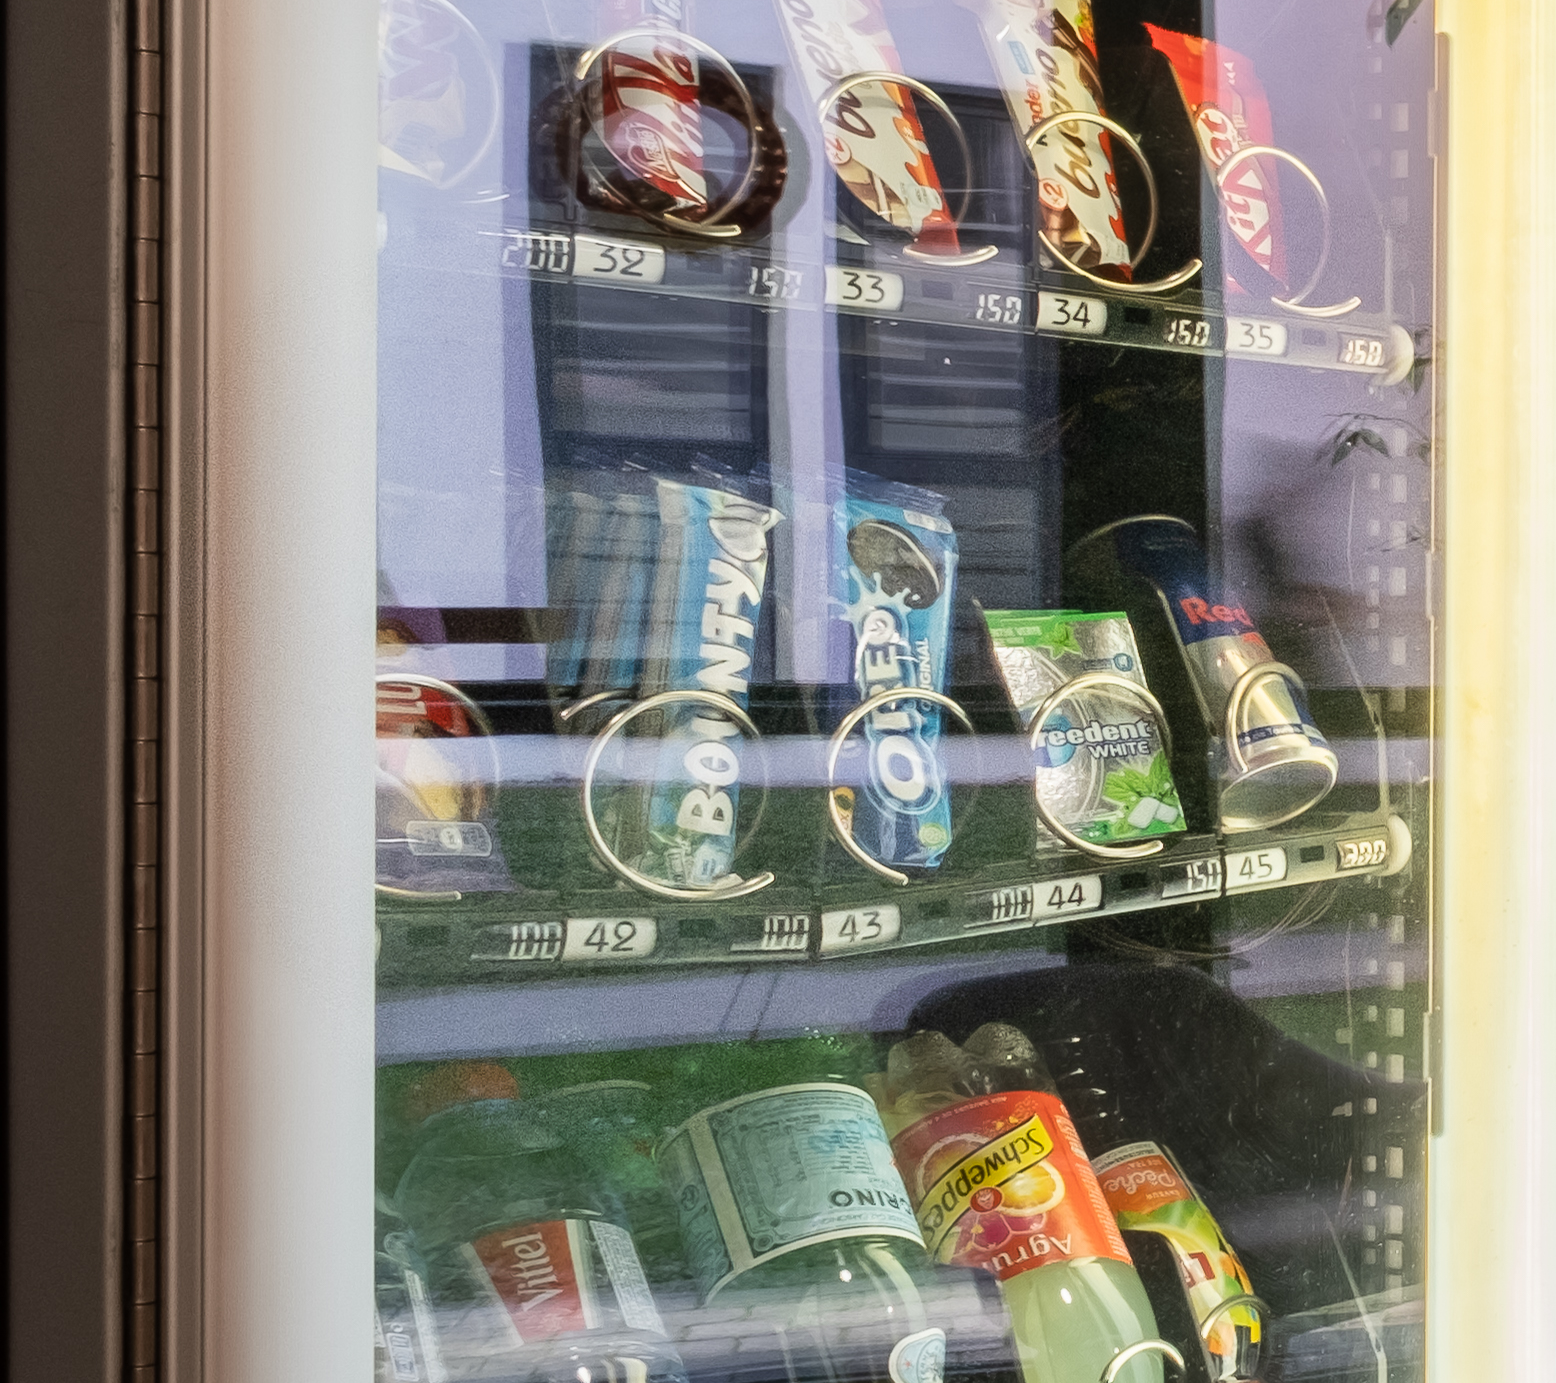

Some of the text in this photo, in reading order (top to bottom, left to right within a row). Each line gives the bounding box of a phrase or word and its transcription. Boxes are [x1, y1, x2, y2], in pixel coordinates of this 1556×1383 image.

[1034, 48, 1101, 200] bueno
[592, 245, 646, 278] 32
[841, 271, 886, 304] 33
[976, 292, 1022, 326] 150
[1051, 298, 1092, 329] 34
[1166, 318, 1211, 347] 150
[1242, 322, 1274, 351] 35
[1341, 338, 1384, 368] 150
[1036, 718, 1152, 748] reedent
[1087, 740, 1151, 760] WHITE
[583, 920, 638, 953] 42
[838, 911, 883, 942] 43
[1046, 883, 1086, 911] 44
[1238, 853, 1273, 881] 45
[919, 1126, 1046, 1242] Schweppes
[1103, 1168, 1176, 1195] Pêche
[501, 1230, 565, 1312] Vittel
